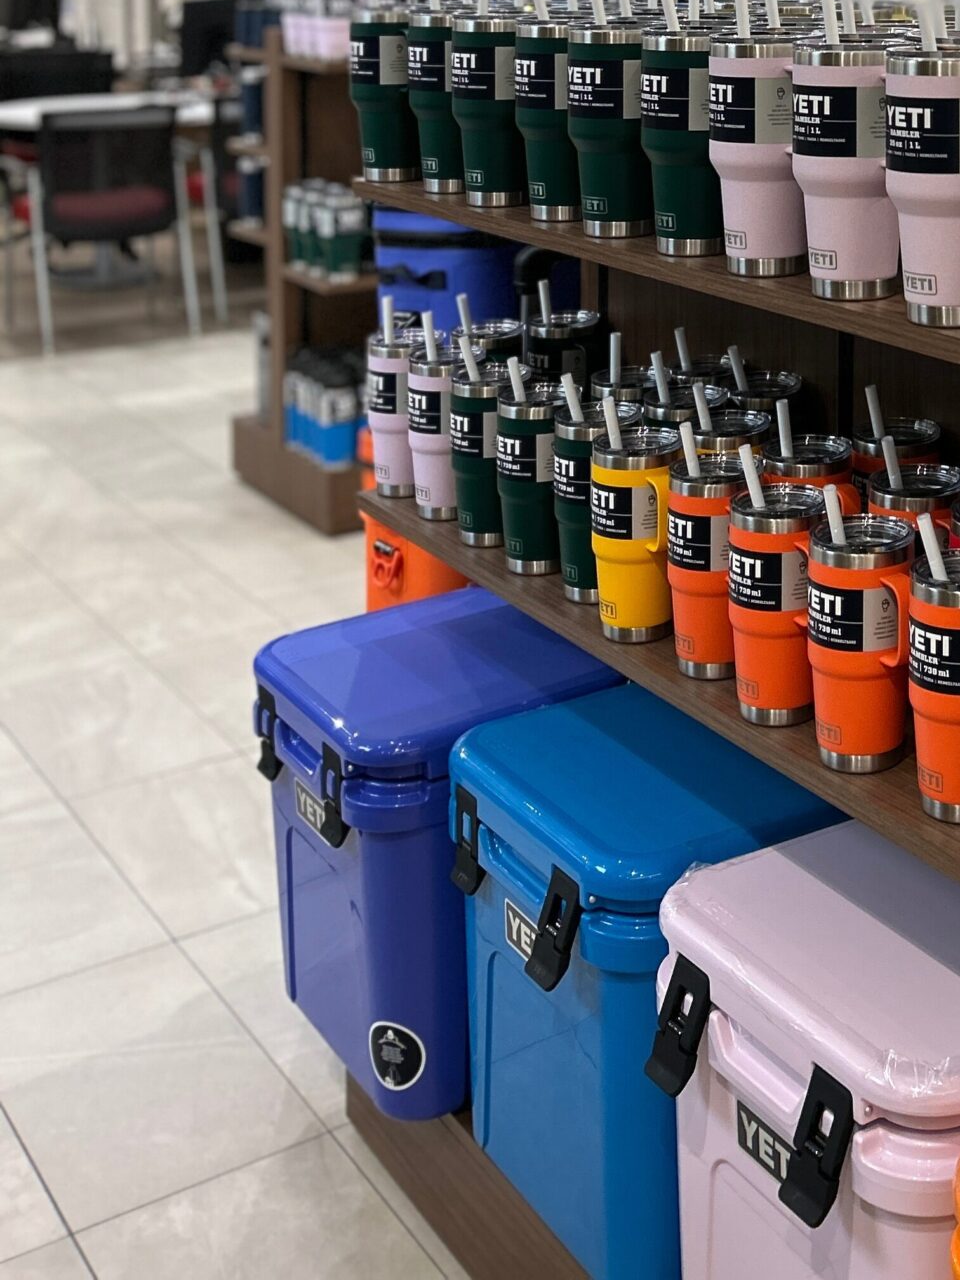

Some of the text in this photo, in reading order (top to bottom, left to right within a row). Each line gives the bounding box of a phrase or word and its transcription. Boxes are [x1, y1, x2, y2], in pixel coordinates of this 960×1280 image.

[408, 46, 428, 62] ETI
[515, 59, 536, 76] ETI
[568, 66, 601, 84] YETI
[709, 82, 733, 103] ETI
[793, 93, 830, 115] YETI
[887, 105, 931, 129] YETI
[915, 141, 921, 150] L
[466, 173, 480, 183] ETI
[657, 215, 673, 228] ETI
[810, 251, 834, 266] YETI
[905, 274, 932, 291] YETI
[408, 392, 427, 410] ETI
[450, 413, 468, 432] ETI
[497, 434, 520, 455] ETI
[554, 456, 575, 477] ETI
[592, 487, 615, 510] ETI
[668, 514, 692, 539] ETI
[752, 589, 761, 598] ml
[600, 601, 614, 616] ETI
[831, 627, 842, 636] ml
[909, 624, 950, 657] YETI
[676, 636, 691, 651] ETI
[939, 669, 950, 678] ml
[920, 768, 939, 788] ETI
[508, 909, 536, 955] YE
[740, 1110, 791, 1180] YET
